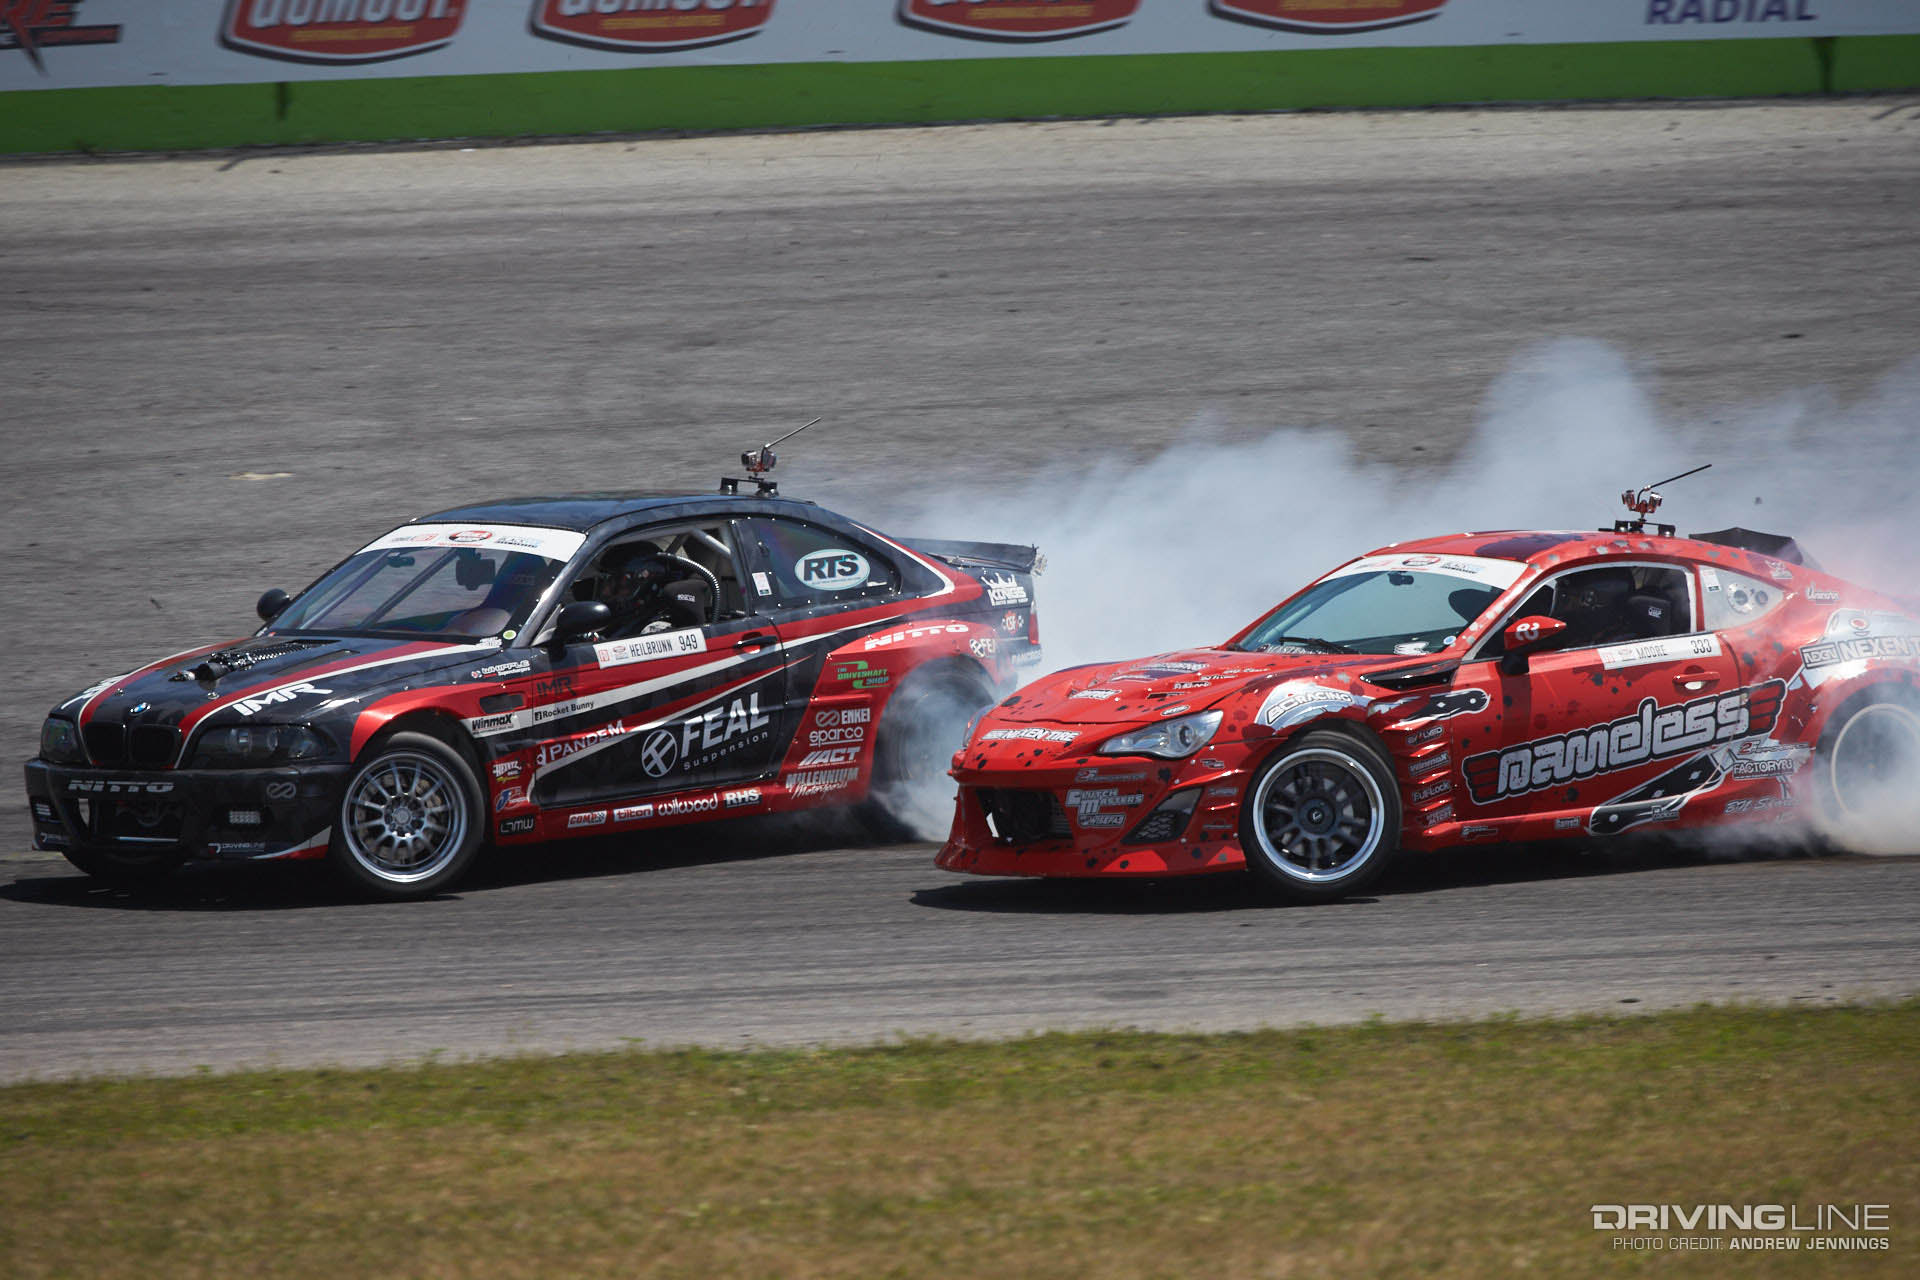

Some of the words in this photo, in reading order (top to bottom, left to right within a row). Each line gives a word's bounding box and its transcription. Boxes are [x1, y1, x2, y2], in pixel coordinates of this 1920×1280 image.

[1646, 0, 1817, 24] RADIAL
[803, 554, 859, 581] RTS
[629, 639, 673, 657] HEILBRUNN
[679, 634, 699, 651] 949
[865, 624, 969, 650] NITTO
[1691, 638, 1713, 654] 333
[537, 676, 577, 697] IMR
[232, 683, 333, 716] IMR
[542, 705, 569, 718] Rocket
[571, 700, 594, 712] Bunny
[681, 692, 769, 758] FEAL
[841, 708, 871, 724] ENKEI
[550, 720, 626, 761] PANDEM
[809, 726, 864, 747] sparco
[68, 780, 174, 793] NITTO
[786, 768, 859, 790] MILLENNIUM
[658, 793, 718, 816] wilwood
[726, 788, 760, 804] RHS
